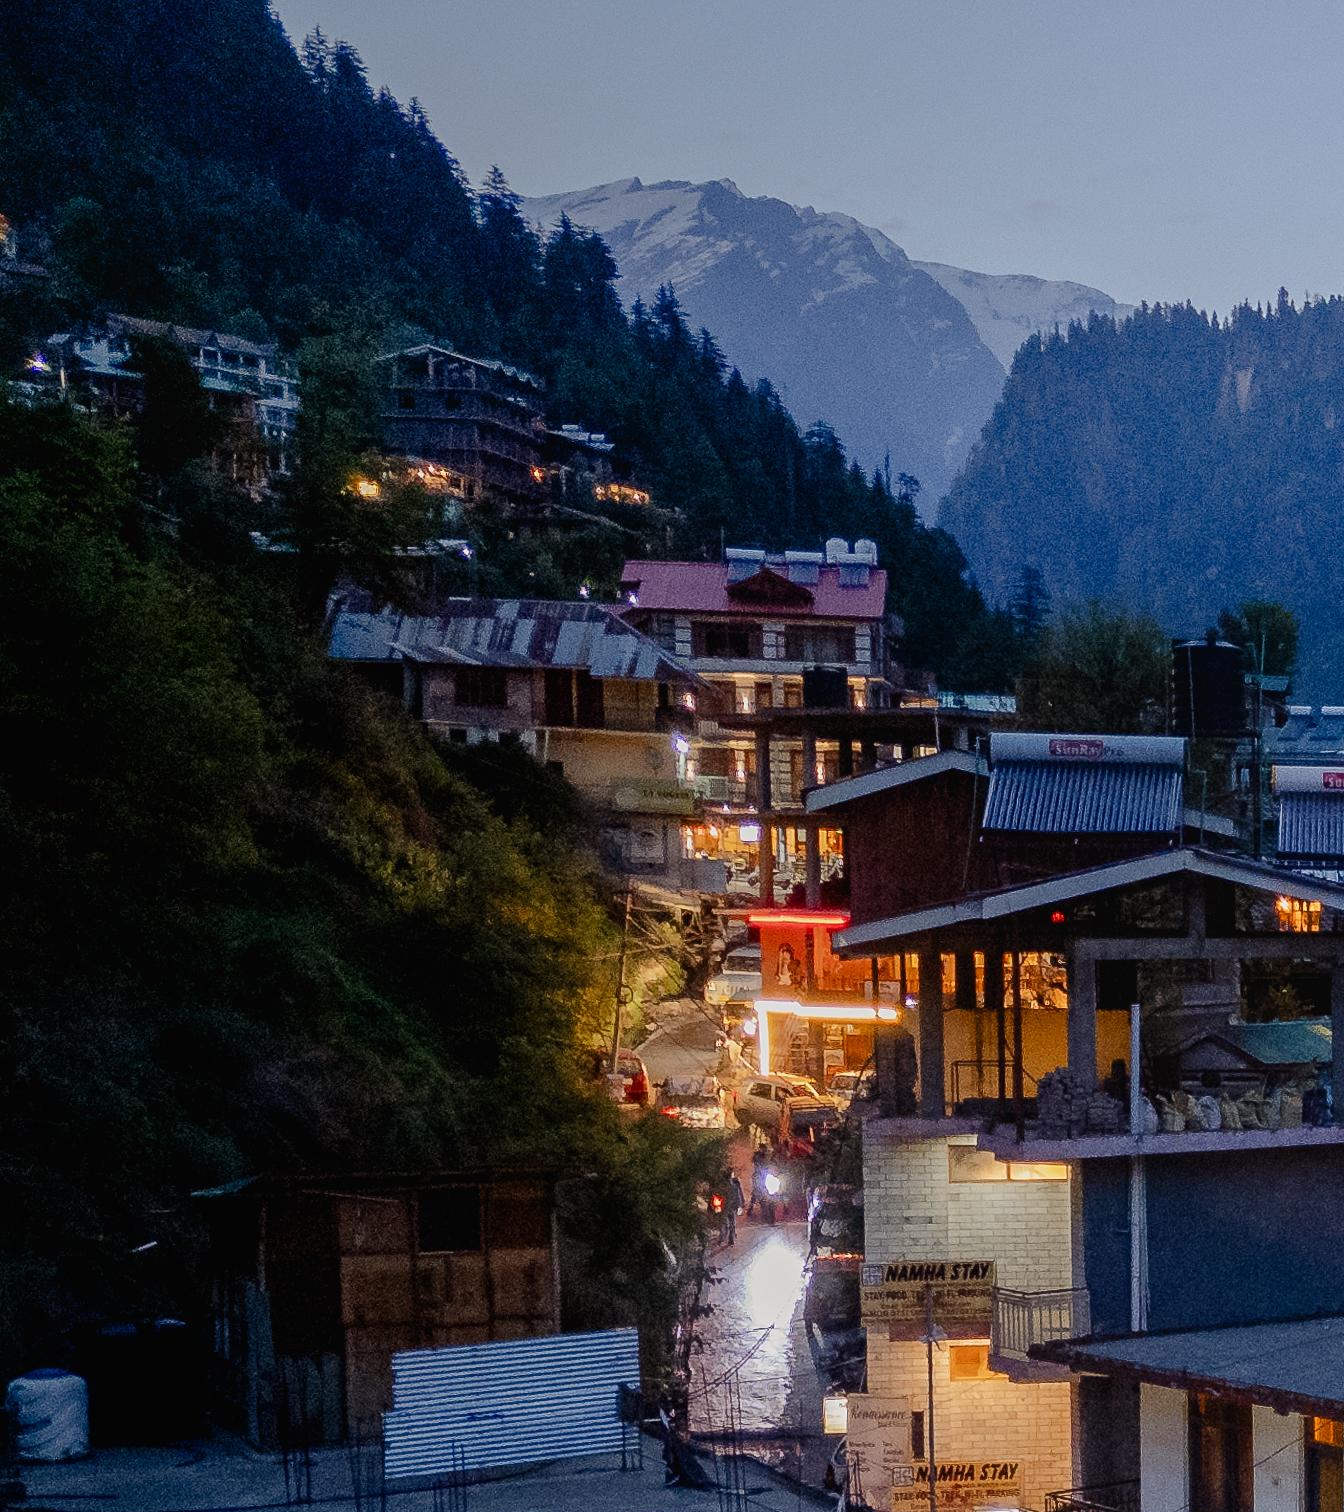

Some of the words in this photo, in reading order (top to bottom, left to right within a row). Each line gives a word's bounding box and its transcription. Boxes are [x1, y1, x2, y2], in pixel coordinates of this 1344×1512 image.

[885, 1263, 946, 1281] NAMHA
[949, 1261, 991, 1280] STAY
[979, 1461, 1019, 1481] STAY
